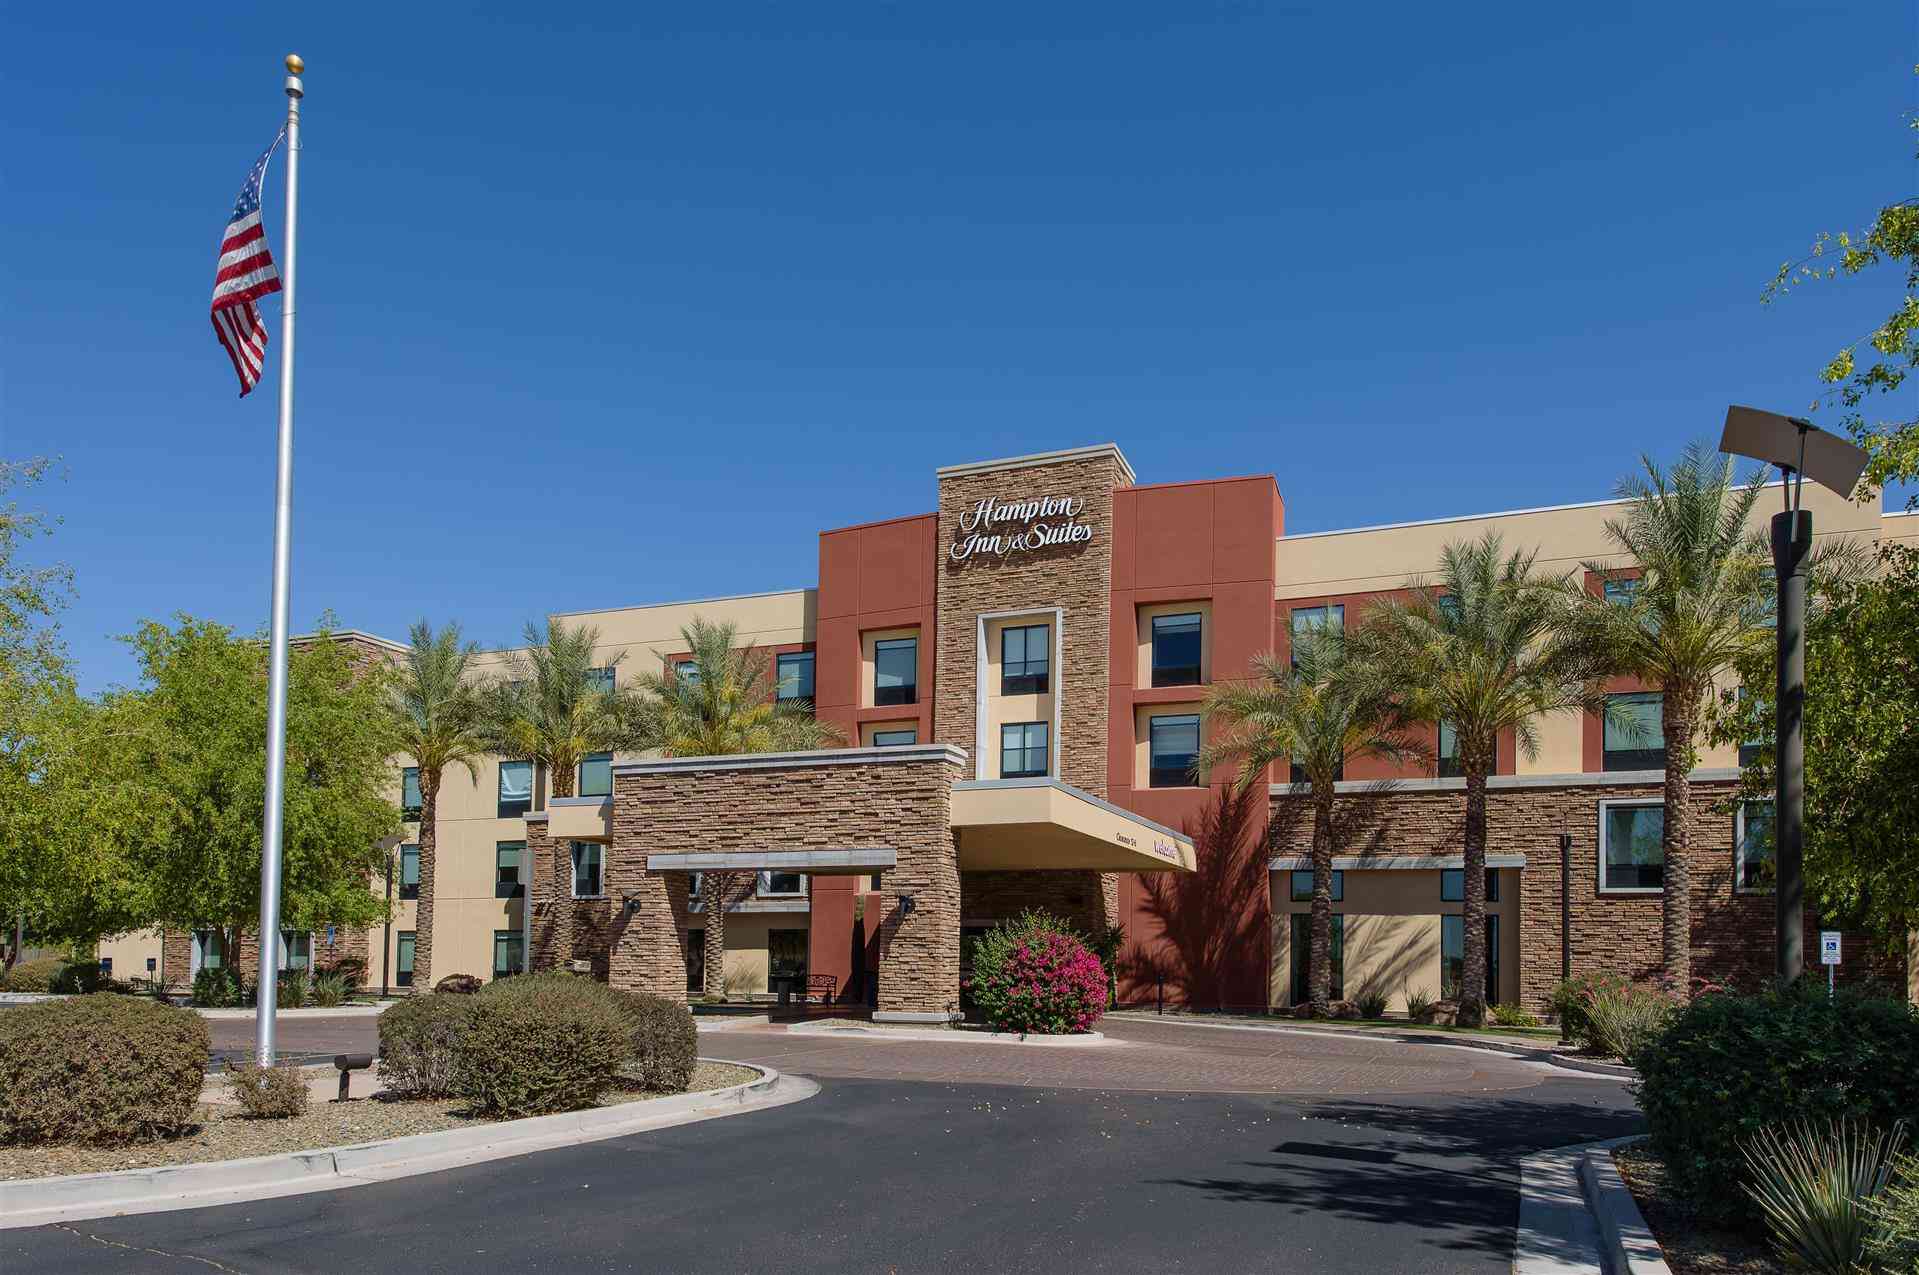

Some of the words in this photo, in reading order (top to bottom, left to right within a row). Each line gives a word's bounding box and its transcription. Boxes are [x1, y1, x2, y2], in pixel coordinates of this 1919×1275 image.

[960, 496, 1083, 530] Hampton
[951, 533, 1012, 559] Inn
[1012, 533, 1027, 550] &
[1025, 522, 1092, 548] Suites
